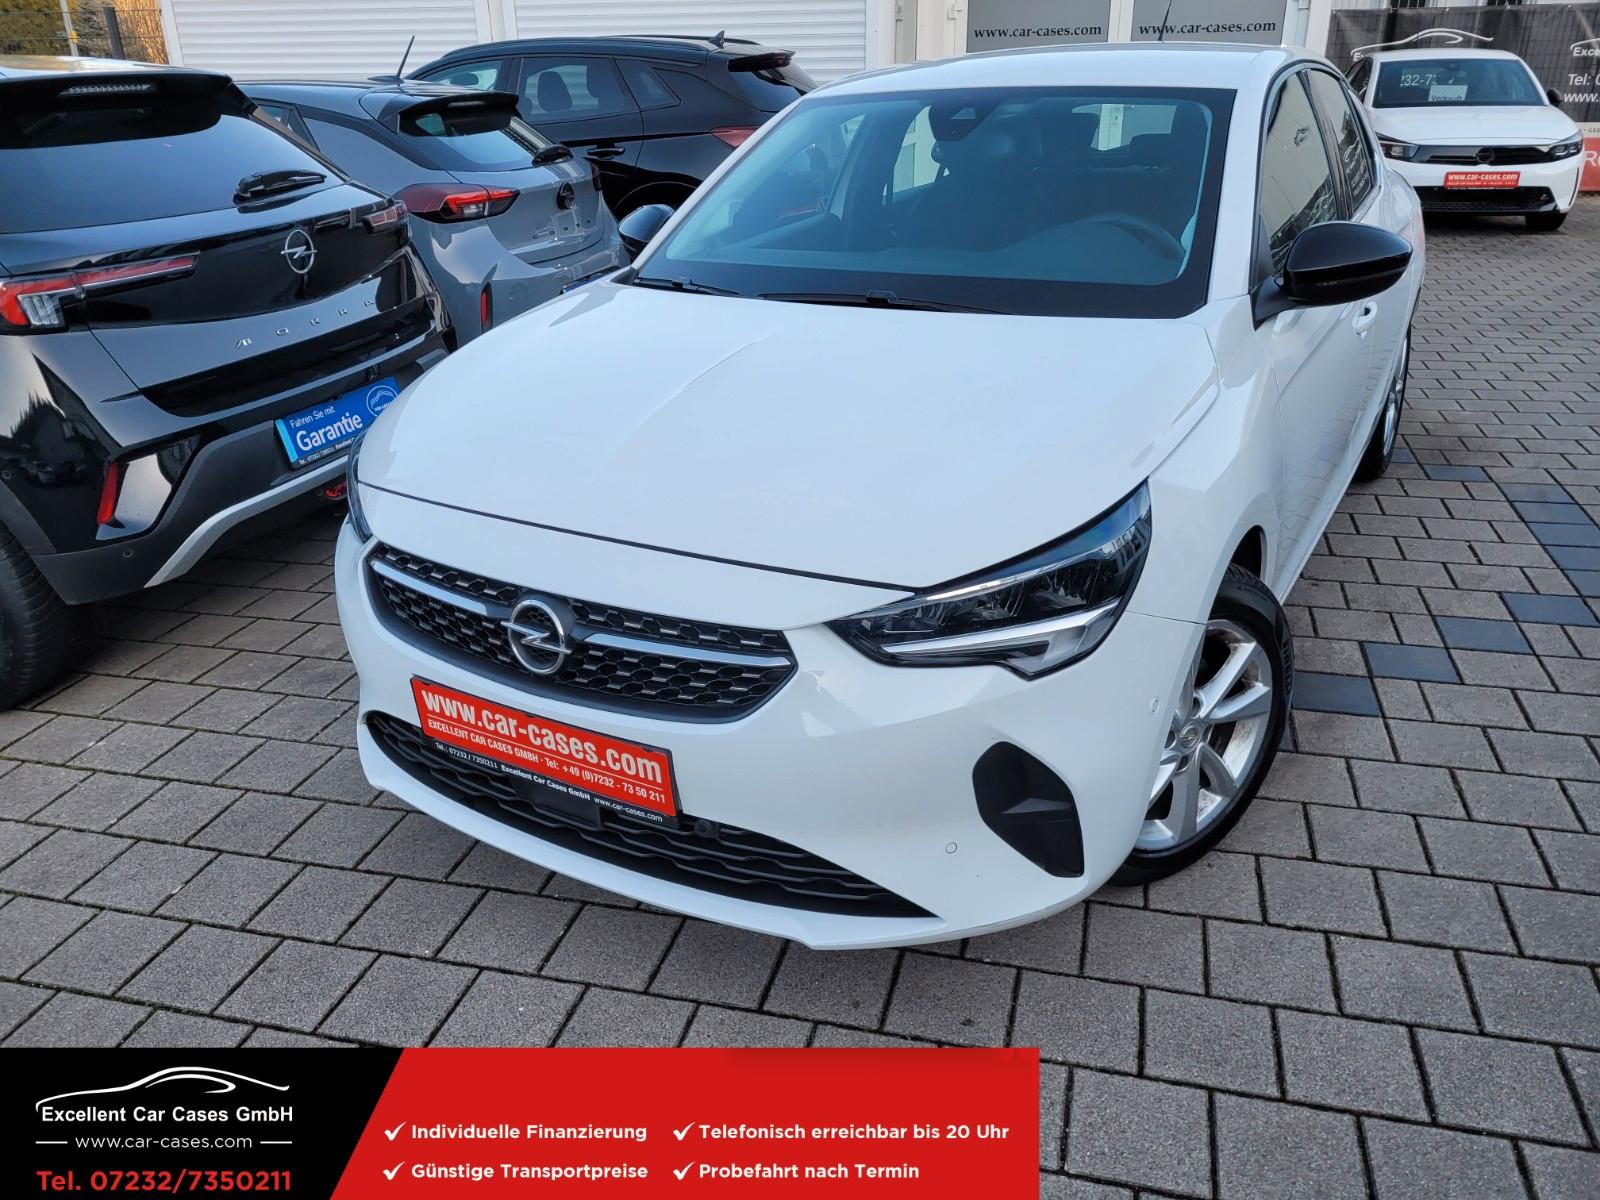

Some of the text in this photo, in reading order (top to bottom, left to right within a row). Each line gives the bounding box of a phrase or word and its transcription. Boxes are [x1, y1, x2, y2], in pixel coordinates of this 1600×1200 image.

[974, 24, 1102, 38] www.car-cases.com
[1139, 21, 1276, 35] www.car-cases.com
[1568, 73, 1591, 86] Tel:
[290, 405, 336, 429] Fahren Sie mit
[296, 412, 363, 451] Garantie
[421, 689, 662, 784] www.car-cases.com
[428, 718, 469, 741] EXCELLENT
[470, 731, 487, 746] CAR
[487, 736, 513, 755] CASES
[515, 745, 539, 764] GMBH
[544, 757, 560, 771] Tel:
[562, 765, 580, 778] +49
[582, 769, 614, 789] (0)7232
[623, 782, 635, 794] 73
[635, 786, 648, 799] 50
[649, 792, 666, 804] 211
[472, 755, 498, 769] 7350211
[501, 764, 532, 781] Excellent
[533, 775, 546, 785] Car
[546, 780, 567, 793] Cases
[568, 787, 591, 801] GmbH
[594, 797, 663, 822] www.car-cases.com
